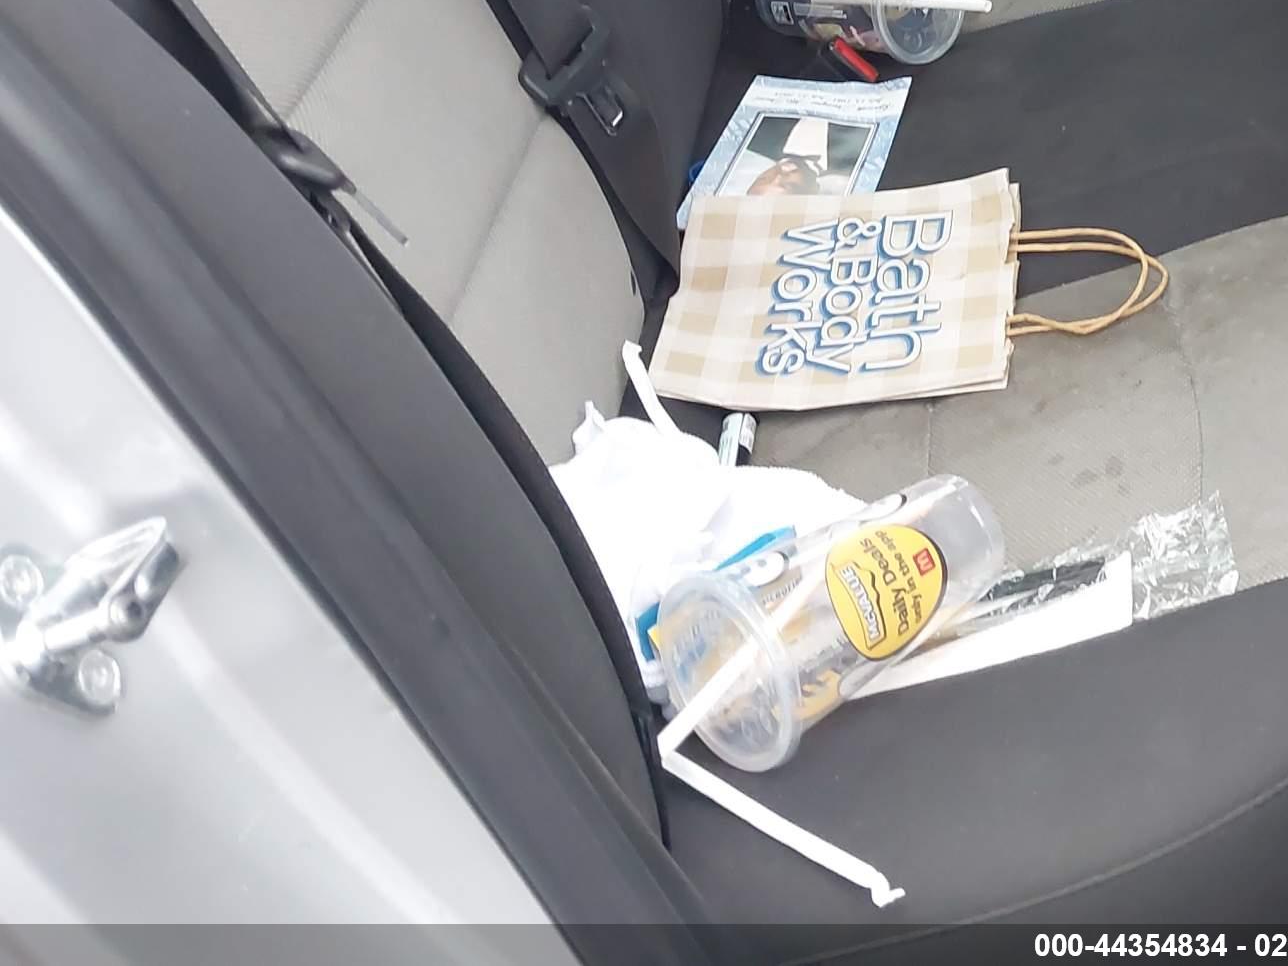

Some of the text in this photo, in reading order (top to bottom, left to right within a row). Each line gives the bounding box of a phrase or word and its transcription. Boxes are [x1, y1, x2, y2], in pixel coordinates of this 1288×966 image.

[756, 216, 840, 374] Works
[802, 215, 883, 373] & Body
[859, 208, 954, 372] Bath
[859, 537, 910, 637] Daily Deals
